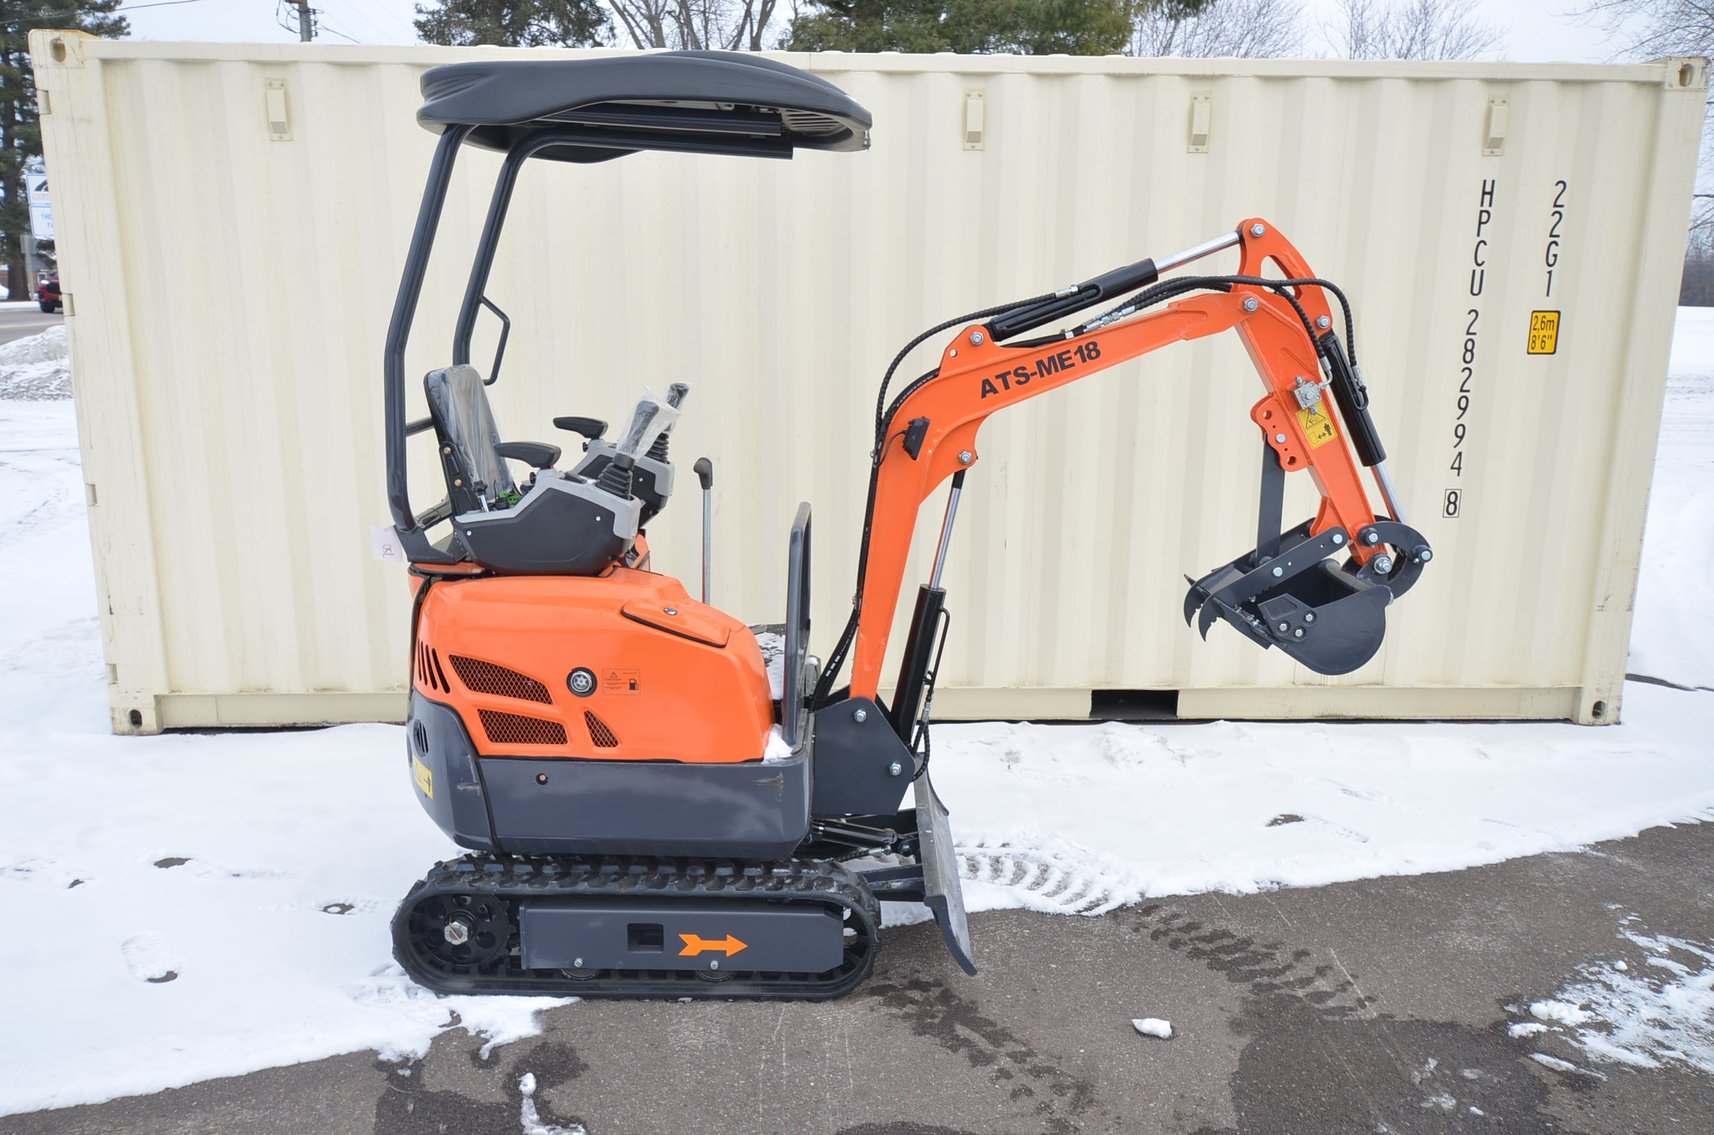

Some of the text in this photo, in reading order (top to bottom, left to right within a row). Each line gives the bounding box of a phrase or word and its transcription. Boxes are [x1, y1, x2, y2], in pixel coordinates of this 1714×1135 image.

[1545, 180, 1567, 297] 22G1
[980, 341, 1101, 399] ATS-ME18
[1445, 179, 1495, 516] HPCU 282994 8
